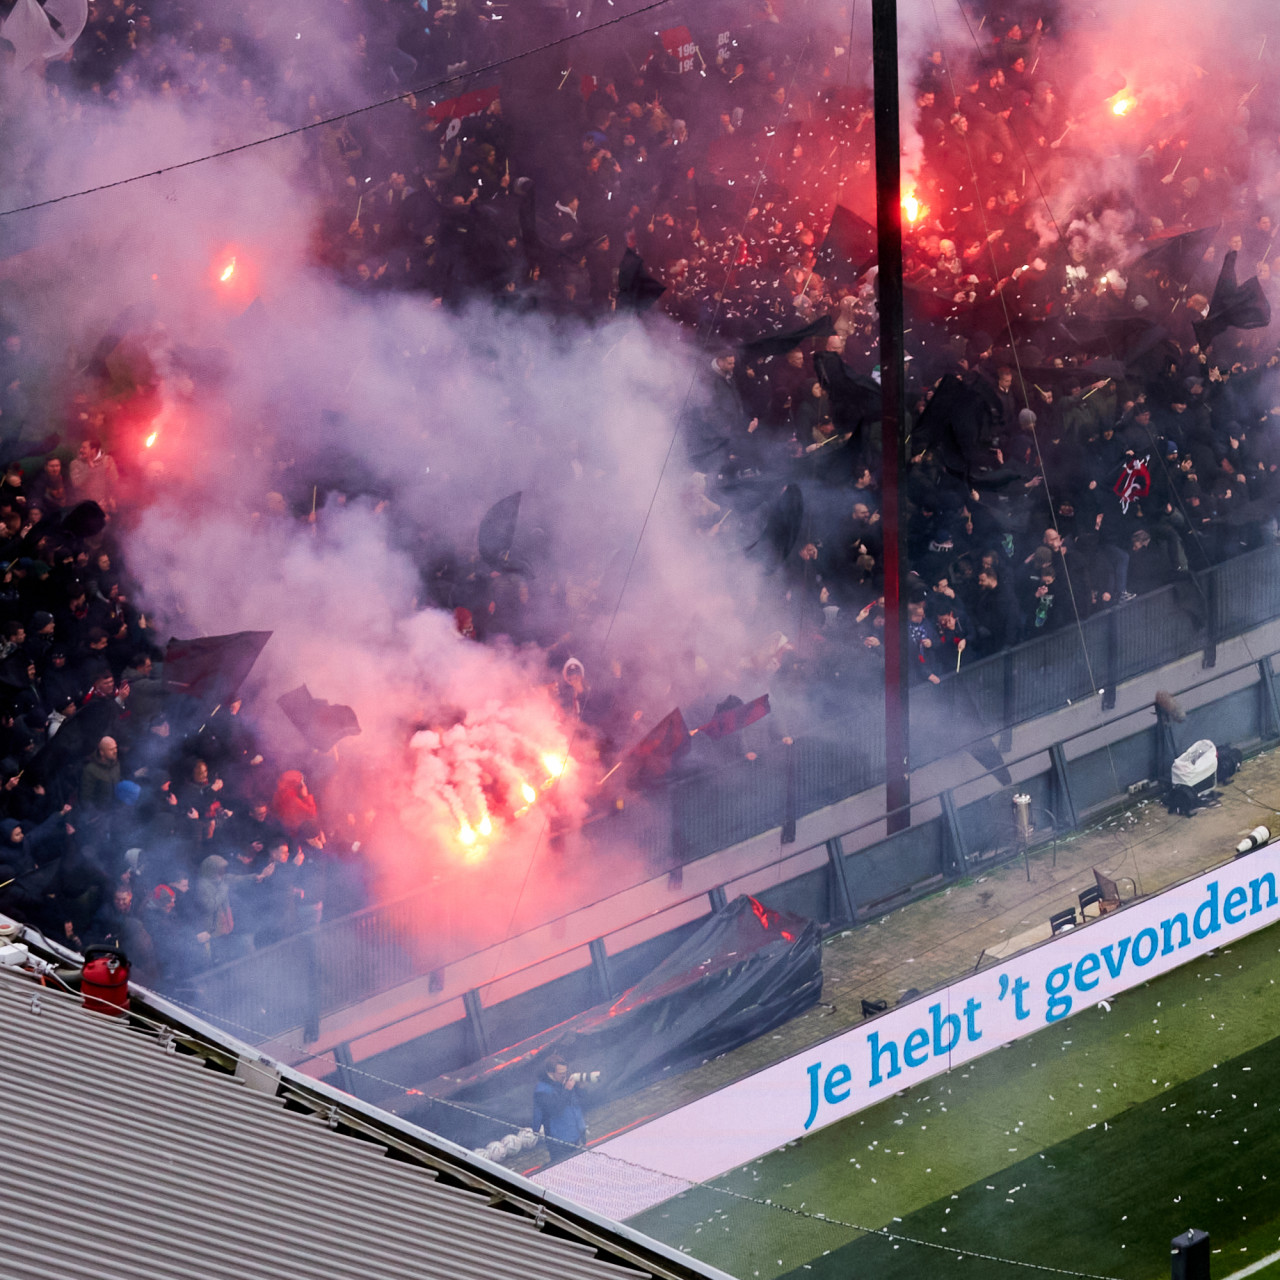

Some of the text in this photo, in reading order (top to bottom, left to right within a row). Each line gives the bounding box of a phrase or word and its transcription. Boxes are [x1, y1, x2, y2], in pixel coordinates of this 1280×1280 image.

[803, 1061, 852, 1131] Je
[866, 996, 983, 1088] hebt
[998, 972, 1031, 1022] 't
